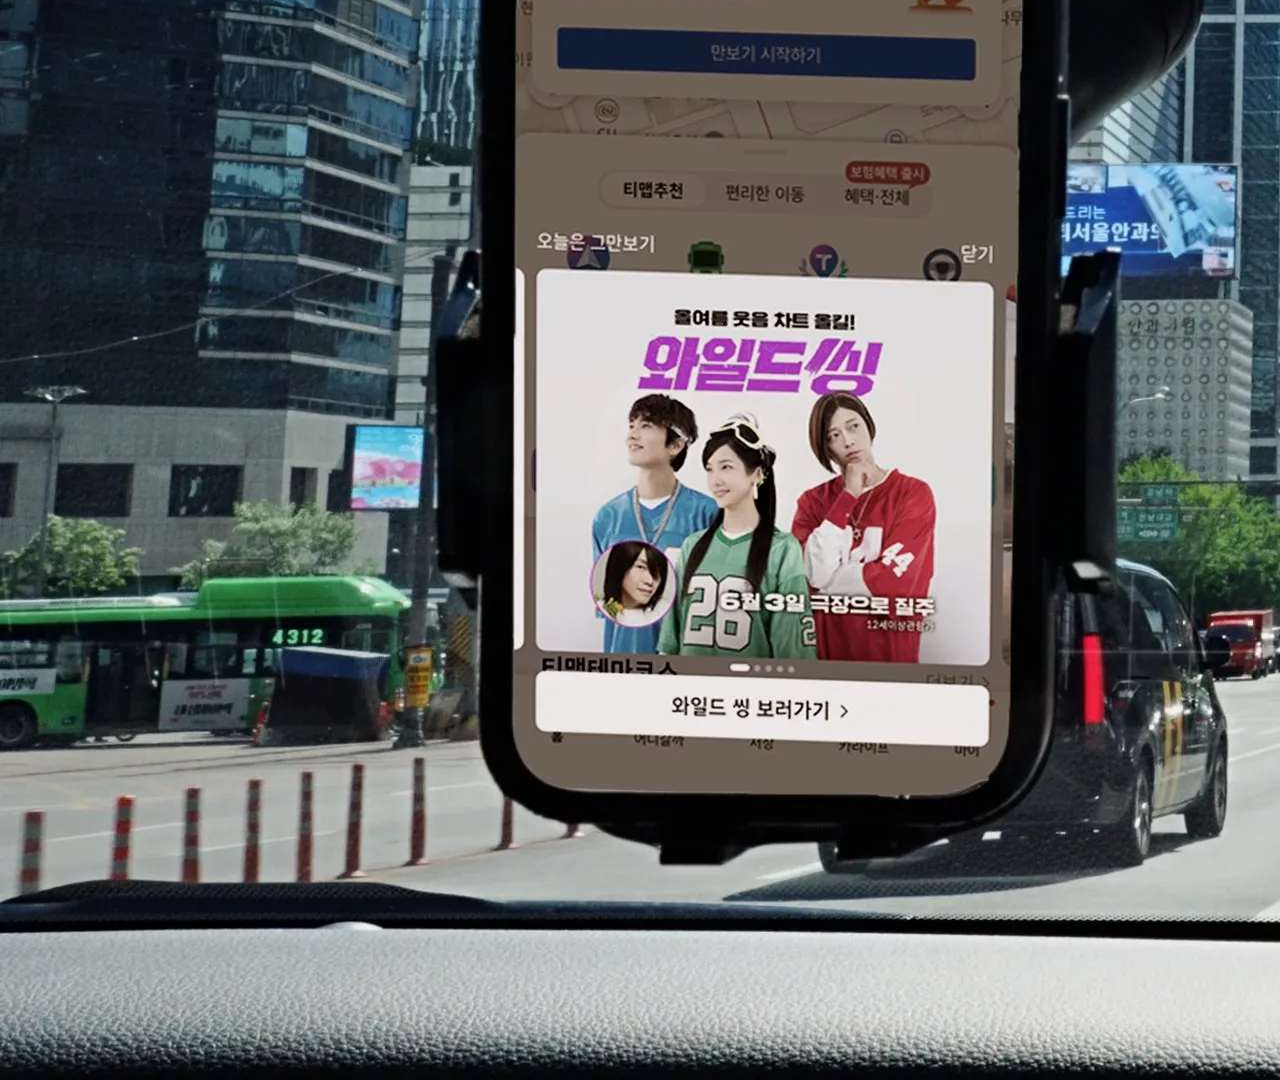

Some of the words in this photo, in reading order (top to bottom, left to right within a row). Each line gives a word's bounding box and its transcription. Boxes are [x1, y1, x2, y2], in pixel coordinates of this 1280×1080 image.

[711, 44, 756, 63] 만보기
[760, 45, 822, 66] 시작하기
[850, 166, 898, 181] 보험혜택
[623, 181, 684, 200] 티맵추천
[726, 184, 770, 203] 편리한
[775, 185, 805, 204] 이동
[537, 232, 586, 252] 오늘은
[590, 233, 656, 254] 그만보기
[960, 244, 994, 265] 닫기
[674, 308, 729, 327] 올여름
[733, 310, 769, 328] 웃음
[774, 311, 810, 329] 차트
[637, 335, 884, 397] 와일드씽
[720, 592, 761, 613] 6월
[764, 593, 805, 613] 3일
[810, 595, 890, 616] 극장으로
[894, 596, 936, 617] 질주
[272, 628, 324, 645] 4312
[672, 696, 726, 717] 와일드
[732, 698, 751, 719] 씽
[757, 699, 830, 721] 보러가기
